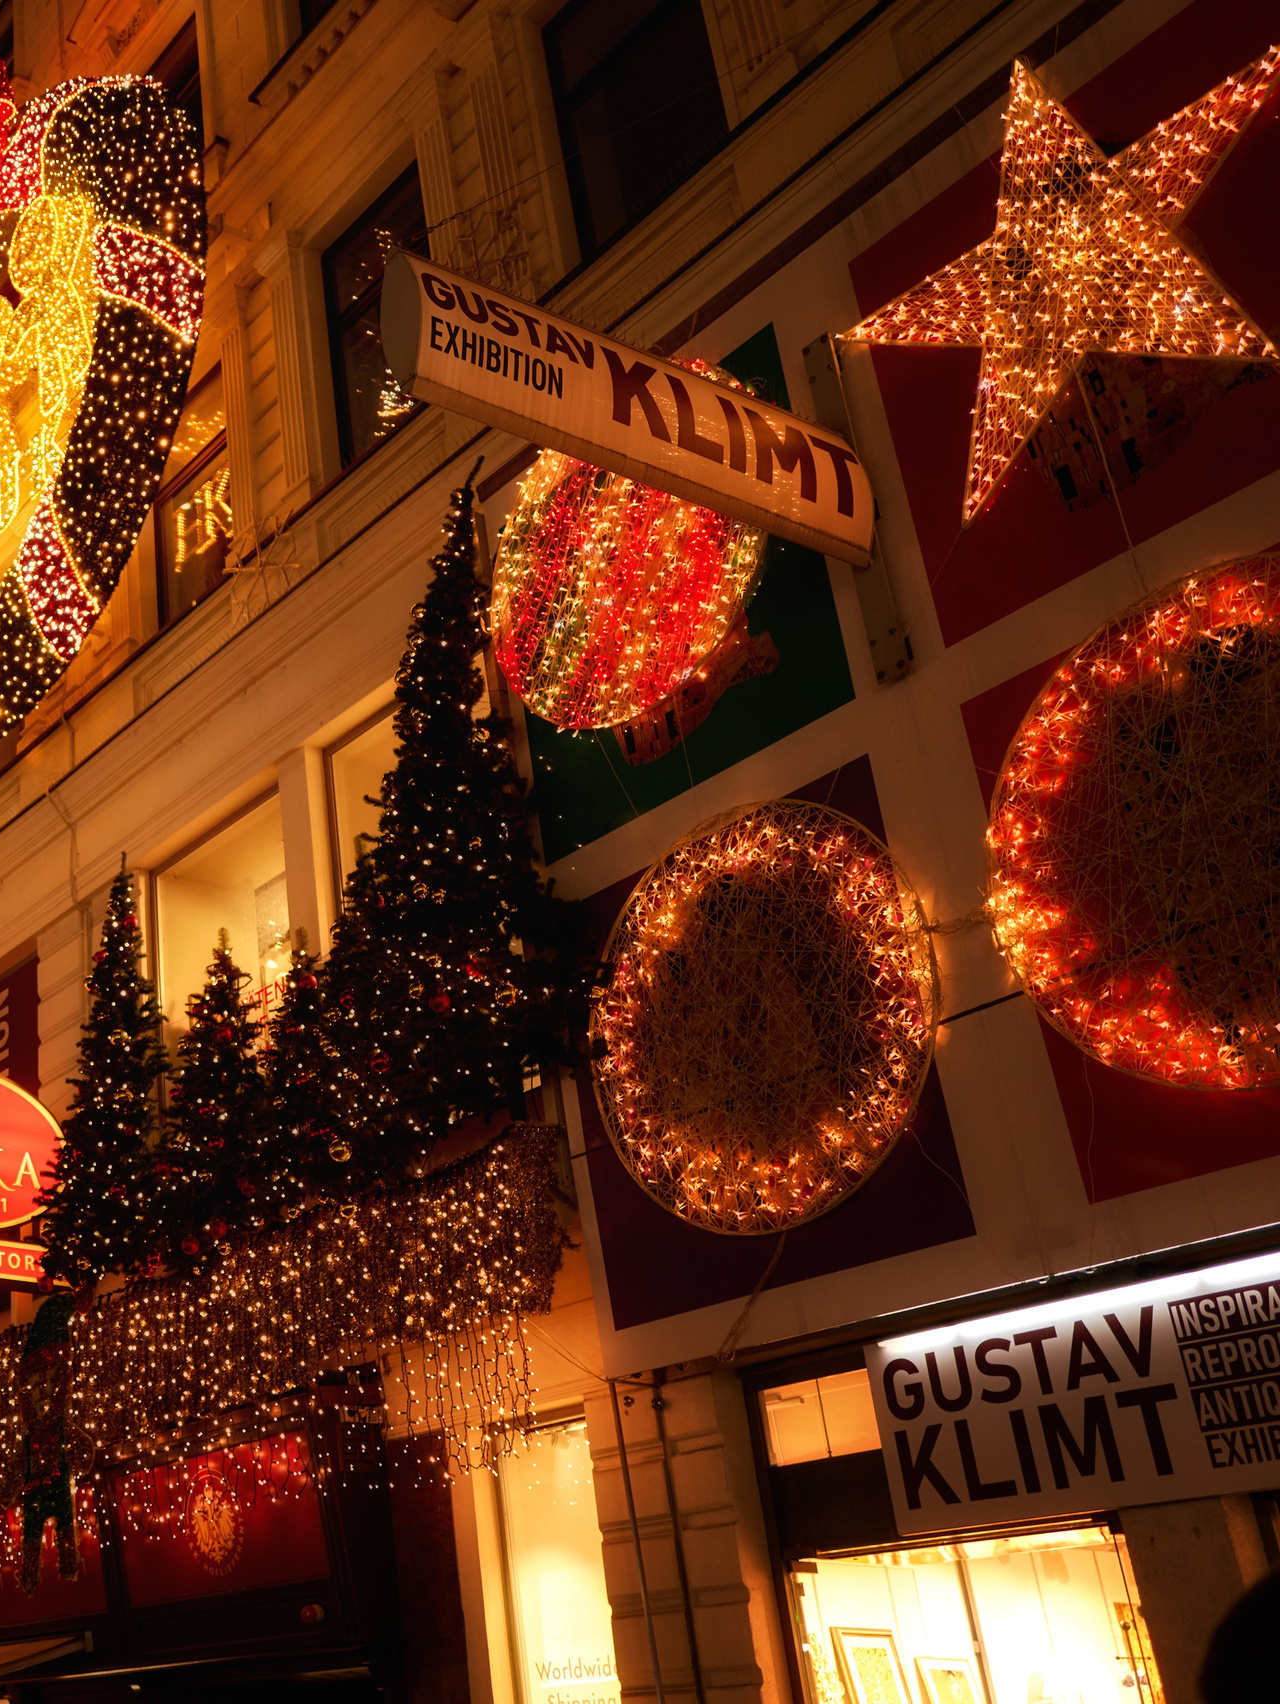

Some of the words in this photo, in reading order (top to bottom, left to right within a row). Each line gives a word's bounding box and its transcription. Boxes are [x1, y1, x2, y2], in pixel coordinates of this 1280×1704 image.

[421, 271, 595, 370] GUSTAV
[601, 346, 859, 518] KLIMT
[430, 315, 564, 399] EXHIBITION
[882, 1305, 1155, 1421] GUSTAV
[1182, 1332, 1280, 1383] REPRO
[893, 1382, 1178, 1511] KLIMT
